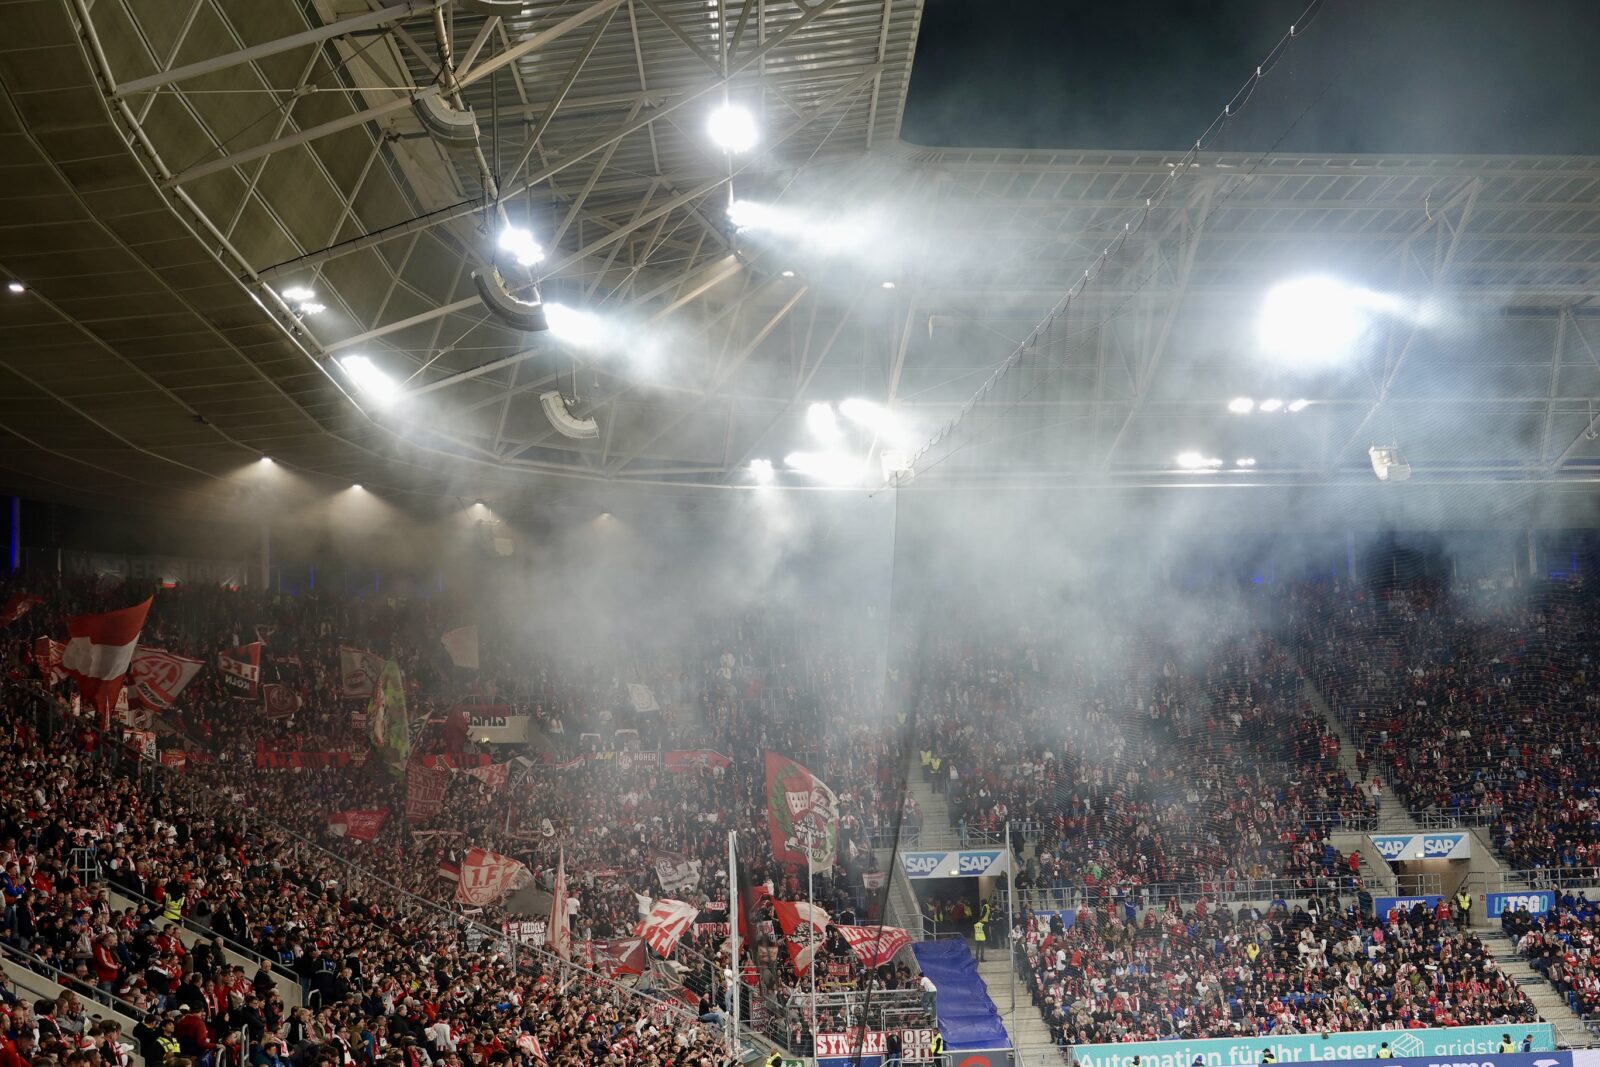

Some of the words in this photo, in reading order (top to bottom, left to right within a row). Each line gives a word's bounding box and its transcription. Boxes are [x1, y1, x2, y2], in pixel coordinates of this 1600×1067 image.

[1374, 841, 1405, 856] SAP
[1424, 839, 1454, 854] SAP
[906, 857, 938, 873] SAP
[960, 856, 992, 872] SAP
[1494, 895, 1548, 914] LETSGO
[1229, 1045, 1263, 1065] für
[1270, 1044, 1303, 1063] Ihr
[1309, 1043, 1376, 1062] Lager
